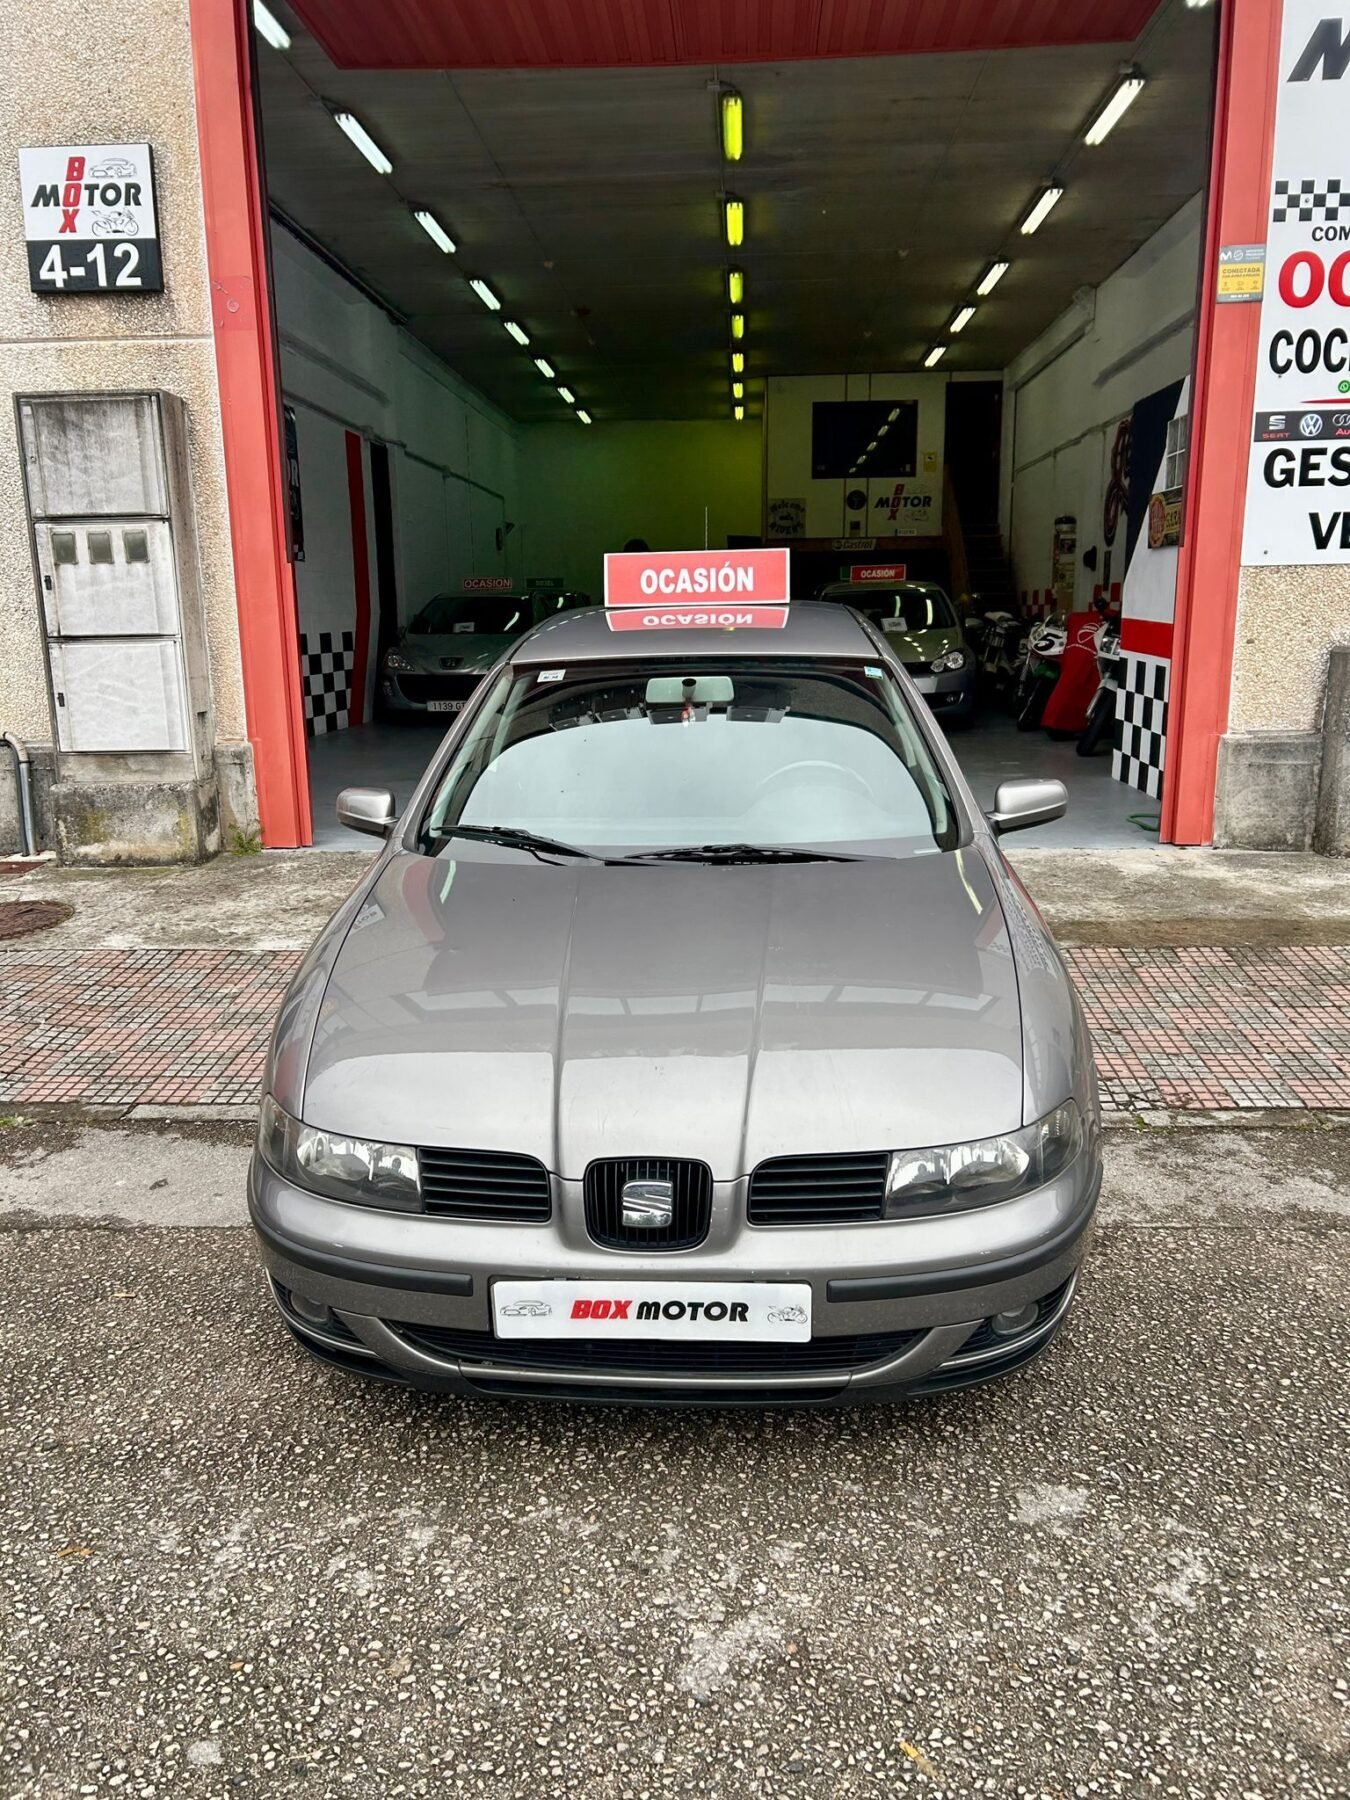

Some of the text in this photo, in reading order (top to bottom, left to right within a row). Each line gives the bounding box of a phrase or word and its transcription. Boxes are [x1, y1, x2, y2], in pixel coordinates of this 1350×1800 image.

[31, 182, 142, 208] MOTOR
[58, 156, 86, 234] BOX
[39, 243, 142, 288] 4-12
[1269, 327, 1350, 375] COC
[1263, 446, 1350, 488] GES
[640, 561, 754, 594] OCASIÓN
[861, 568, 896, 578] OCASIÓN
[570, 1299, 749, 1322] BOX MOTOR
